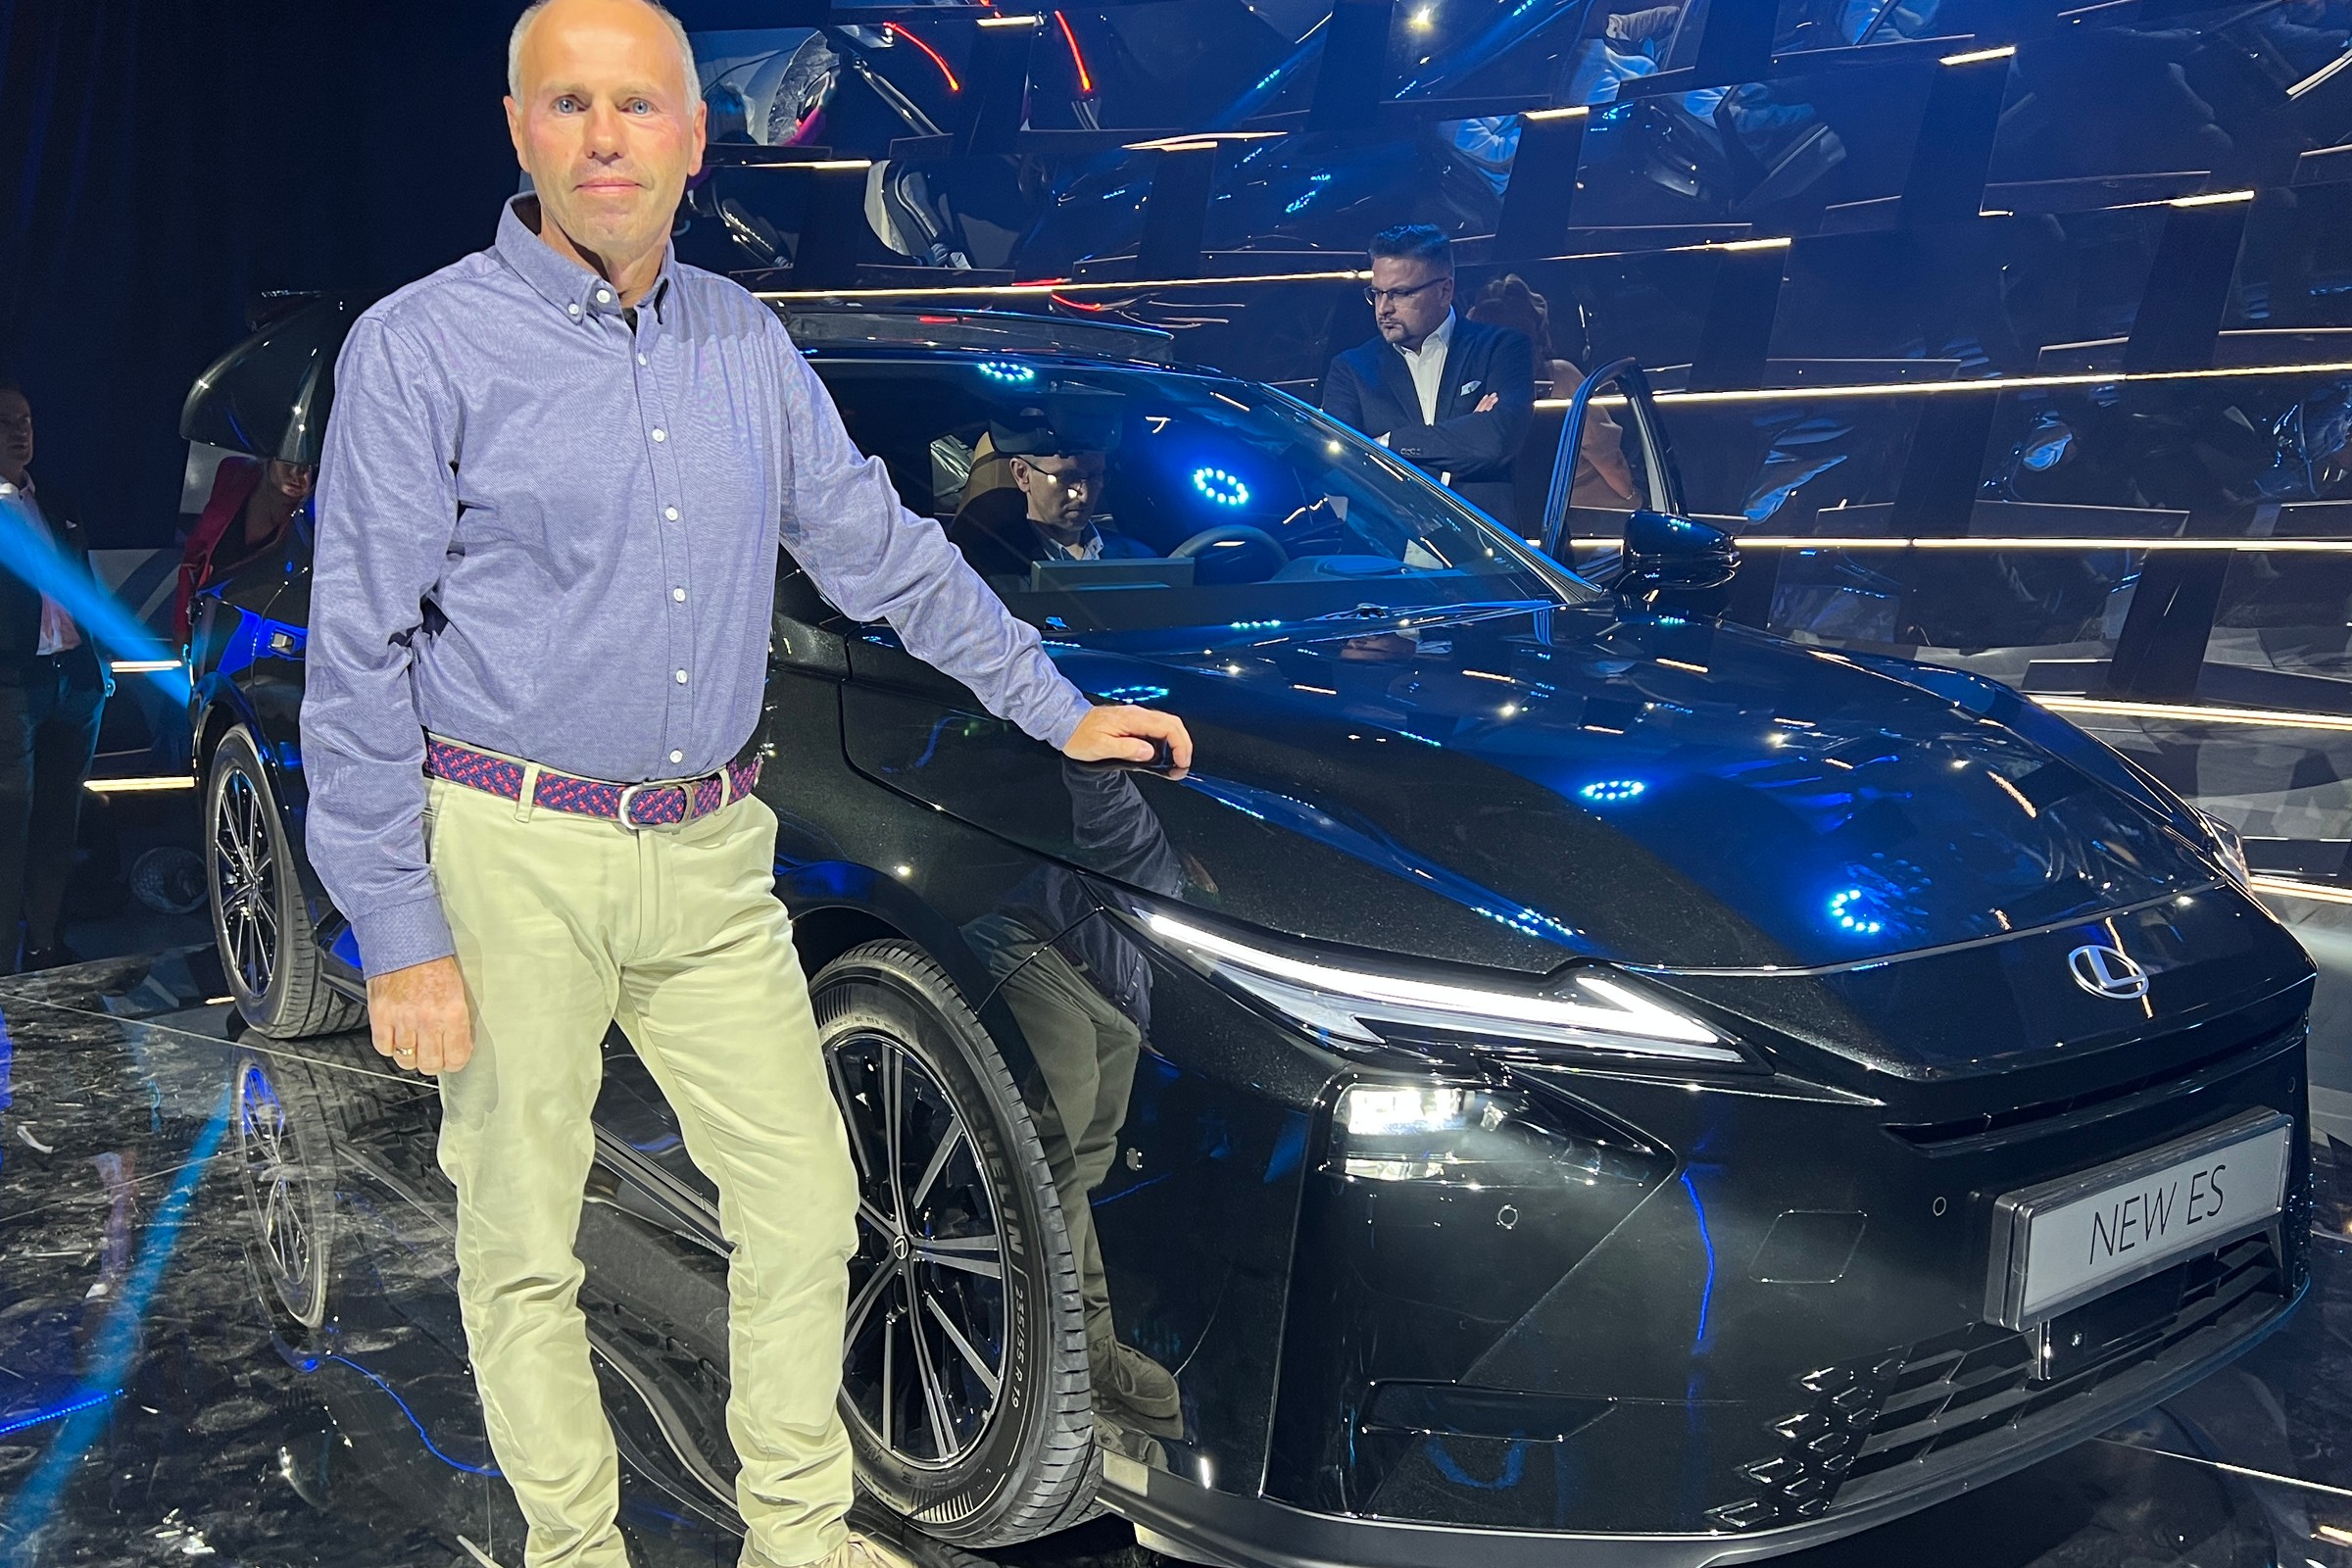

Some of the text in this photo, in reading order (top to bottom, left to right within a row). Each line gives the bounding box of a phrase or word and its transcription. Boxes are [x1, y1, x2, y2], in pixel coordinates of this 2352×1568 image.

[2089, 1164, 2227, 1265] NEW ES
[1012, 1284, 1025, 1408] 235/55 R 19
